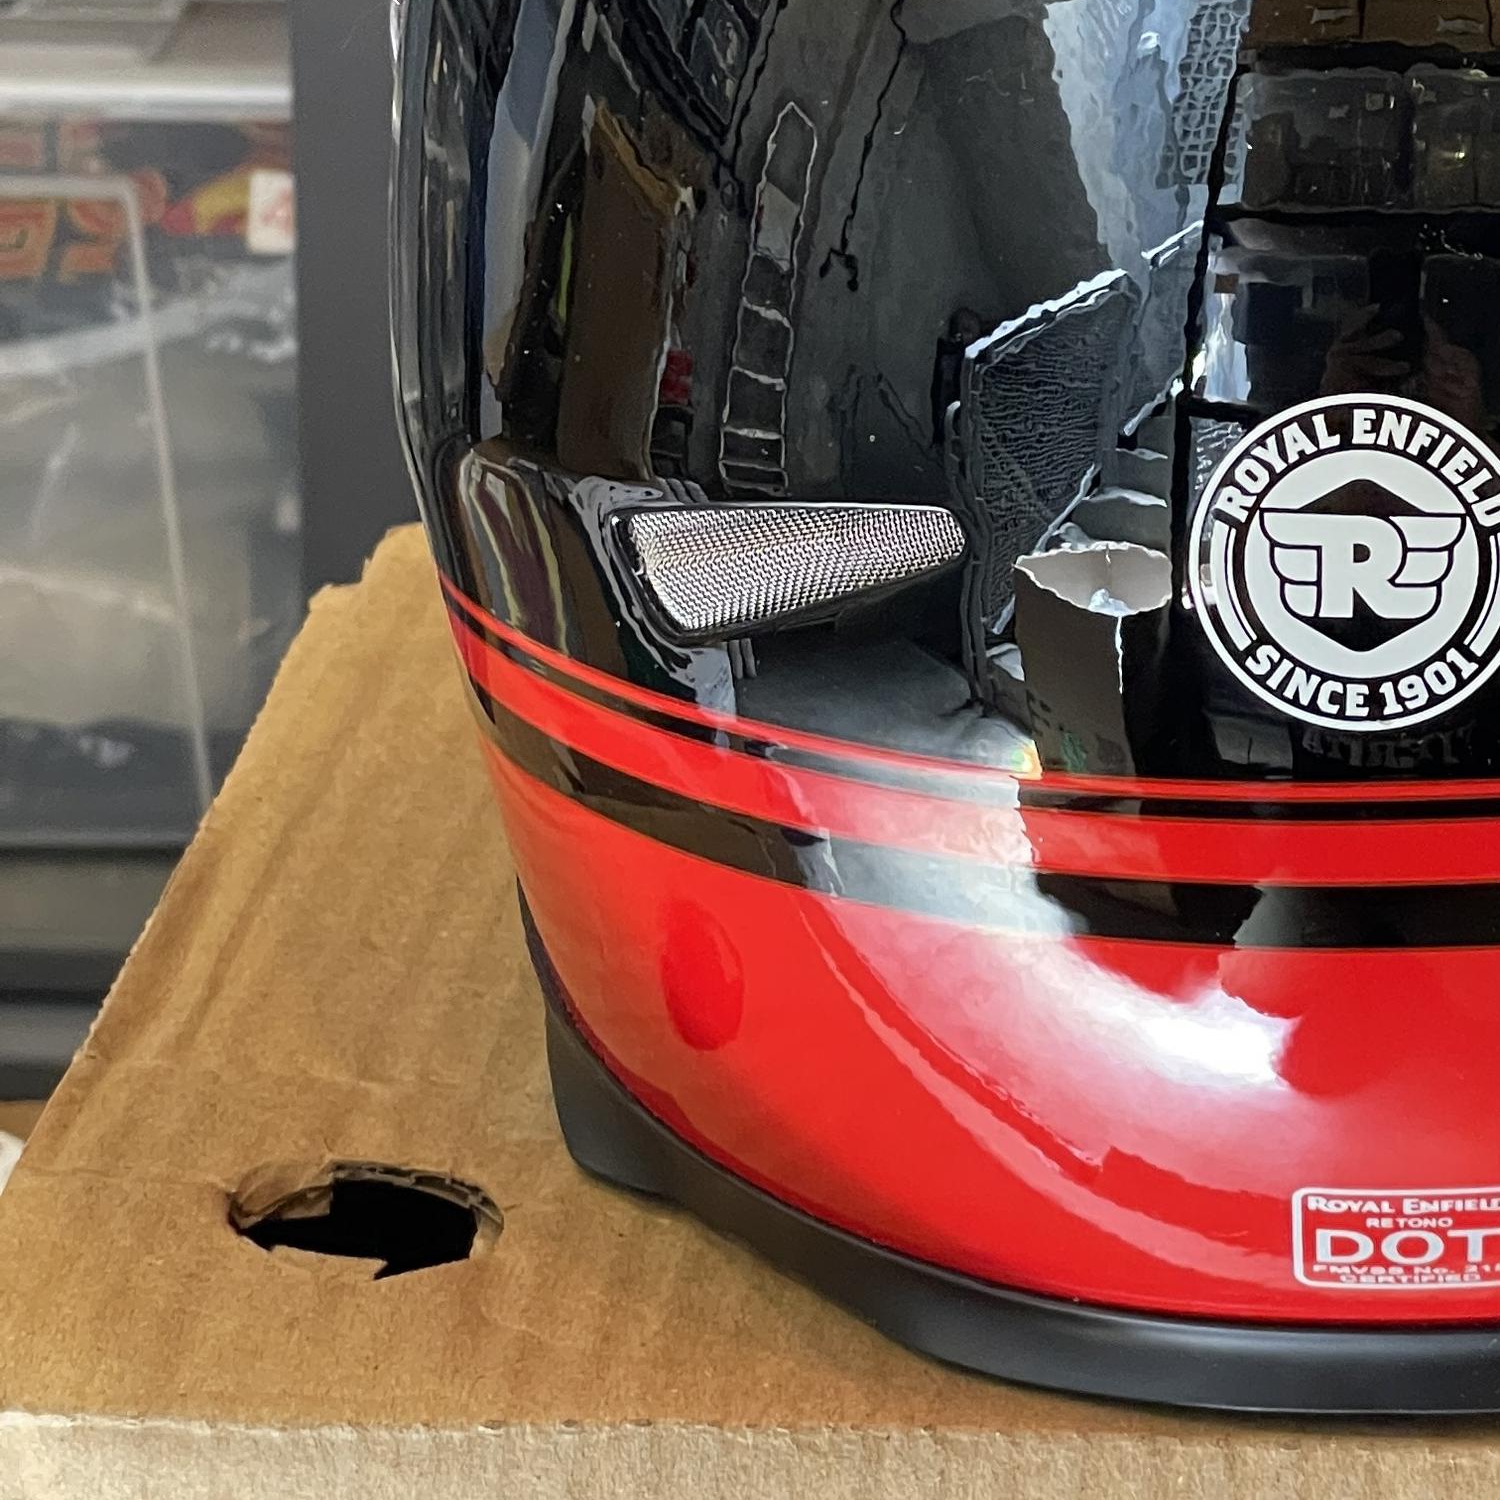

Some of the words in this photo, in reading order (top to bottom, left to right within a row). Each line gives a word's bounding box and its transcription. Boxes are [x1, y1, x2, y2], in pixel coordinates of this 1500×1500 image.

[1214, 414, 1341, 524] ROYAL
[1244, 644, 1370, 717] SINCE
[1379, 647, 1480, 716] 1901
